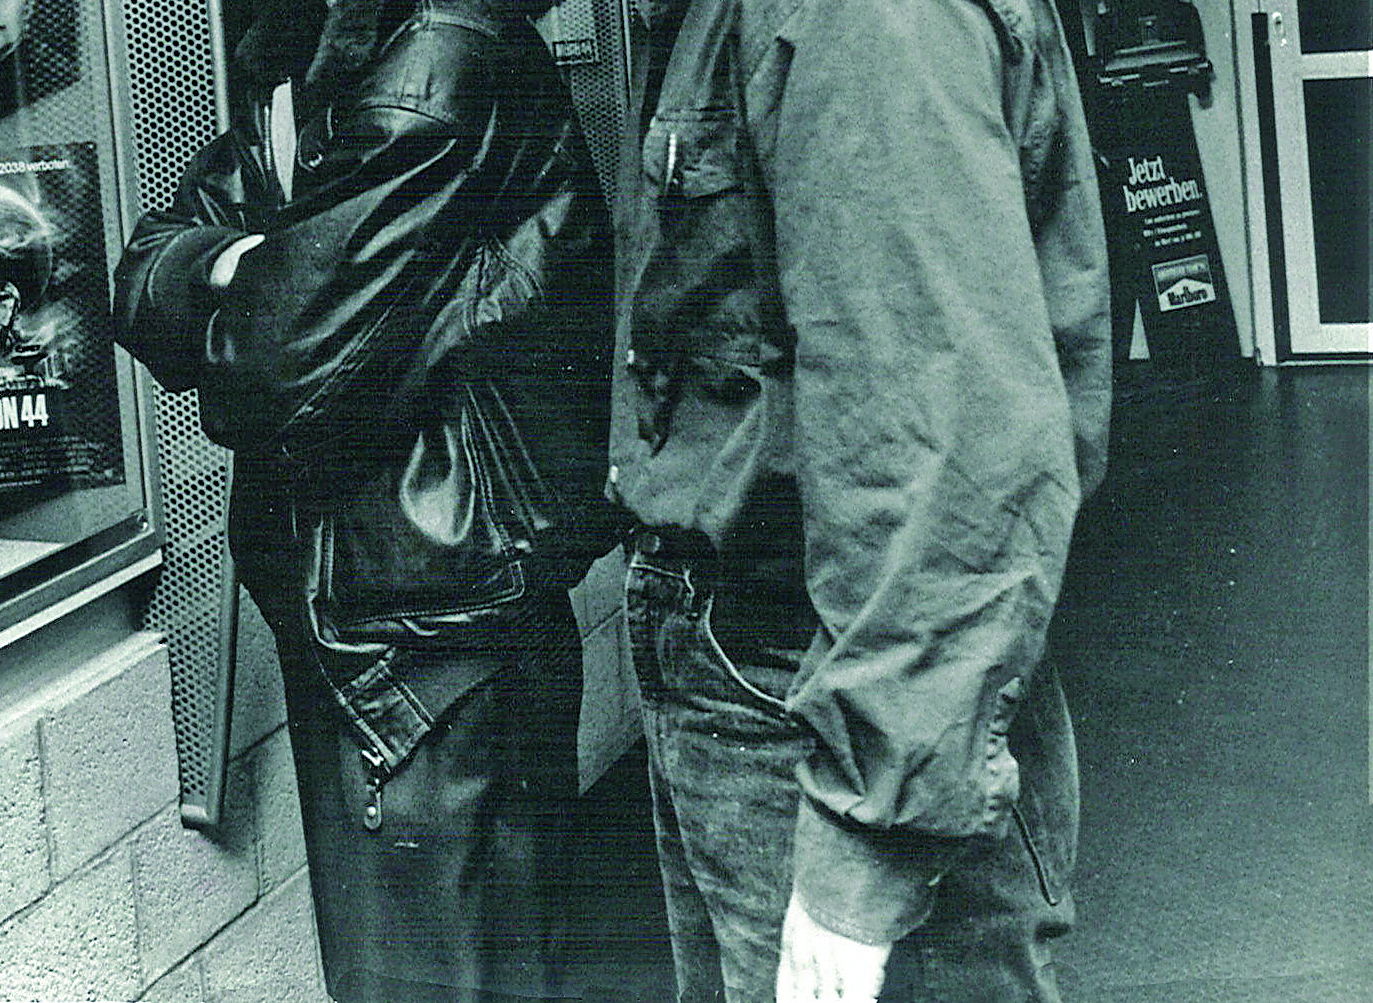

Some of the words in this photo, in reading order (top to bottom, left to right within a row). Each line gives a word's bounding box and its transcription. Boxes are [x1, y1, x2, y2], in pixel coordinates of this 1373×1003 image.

[1128, 156, 1166, 186] Jetzt
[1123, 177, 1203, 213] bewerben.
[21, 394, 49, 428] 44
